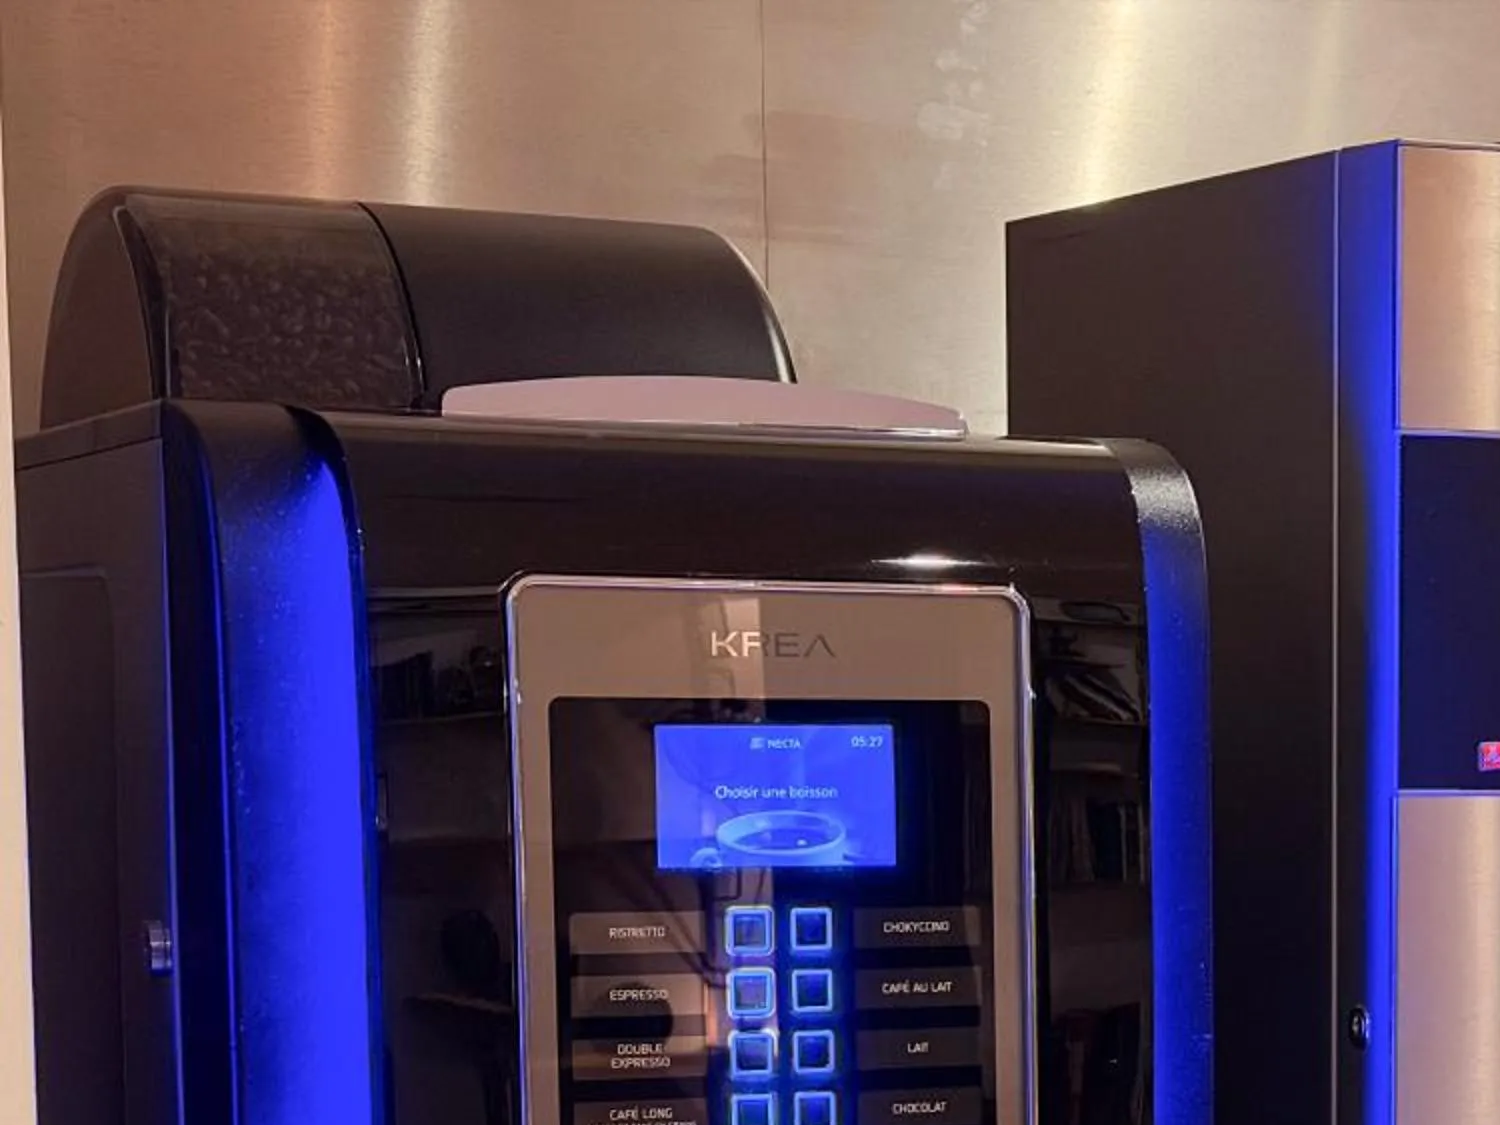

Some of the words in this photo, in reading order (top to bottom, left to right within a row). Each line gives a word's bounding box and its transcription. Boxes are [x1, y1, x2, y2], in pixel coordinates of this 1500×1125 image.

[711, 630, 836, 657] KREA
[851, 736, 883, 748] 05:27
[715, 785, 758, 799] Choisir
[762, 788, 787, 799] une
[789, 786, 838, 799] boisson
[893, 1101, 947, 1114] CHOCOLAT
